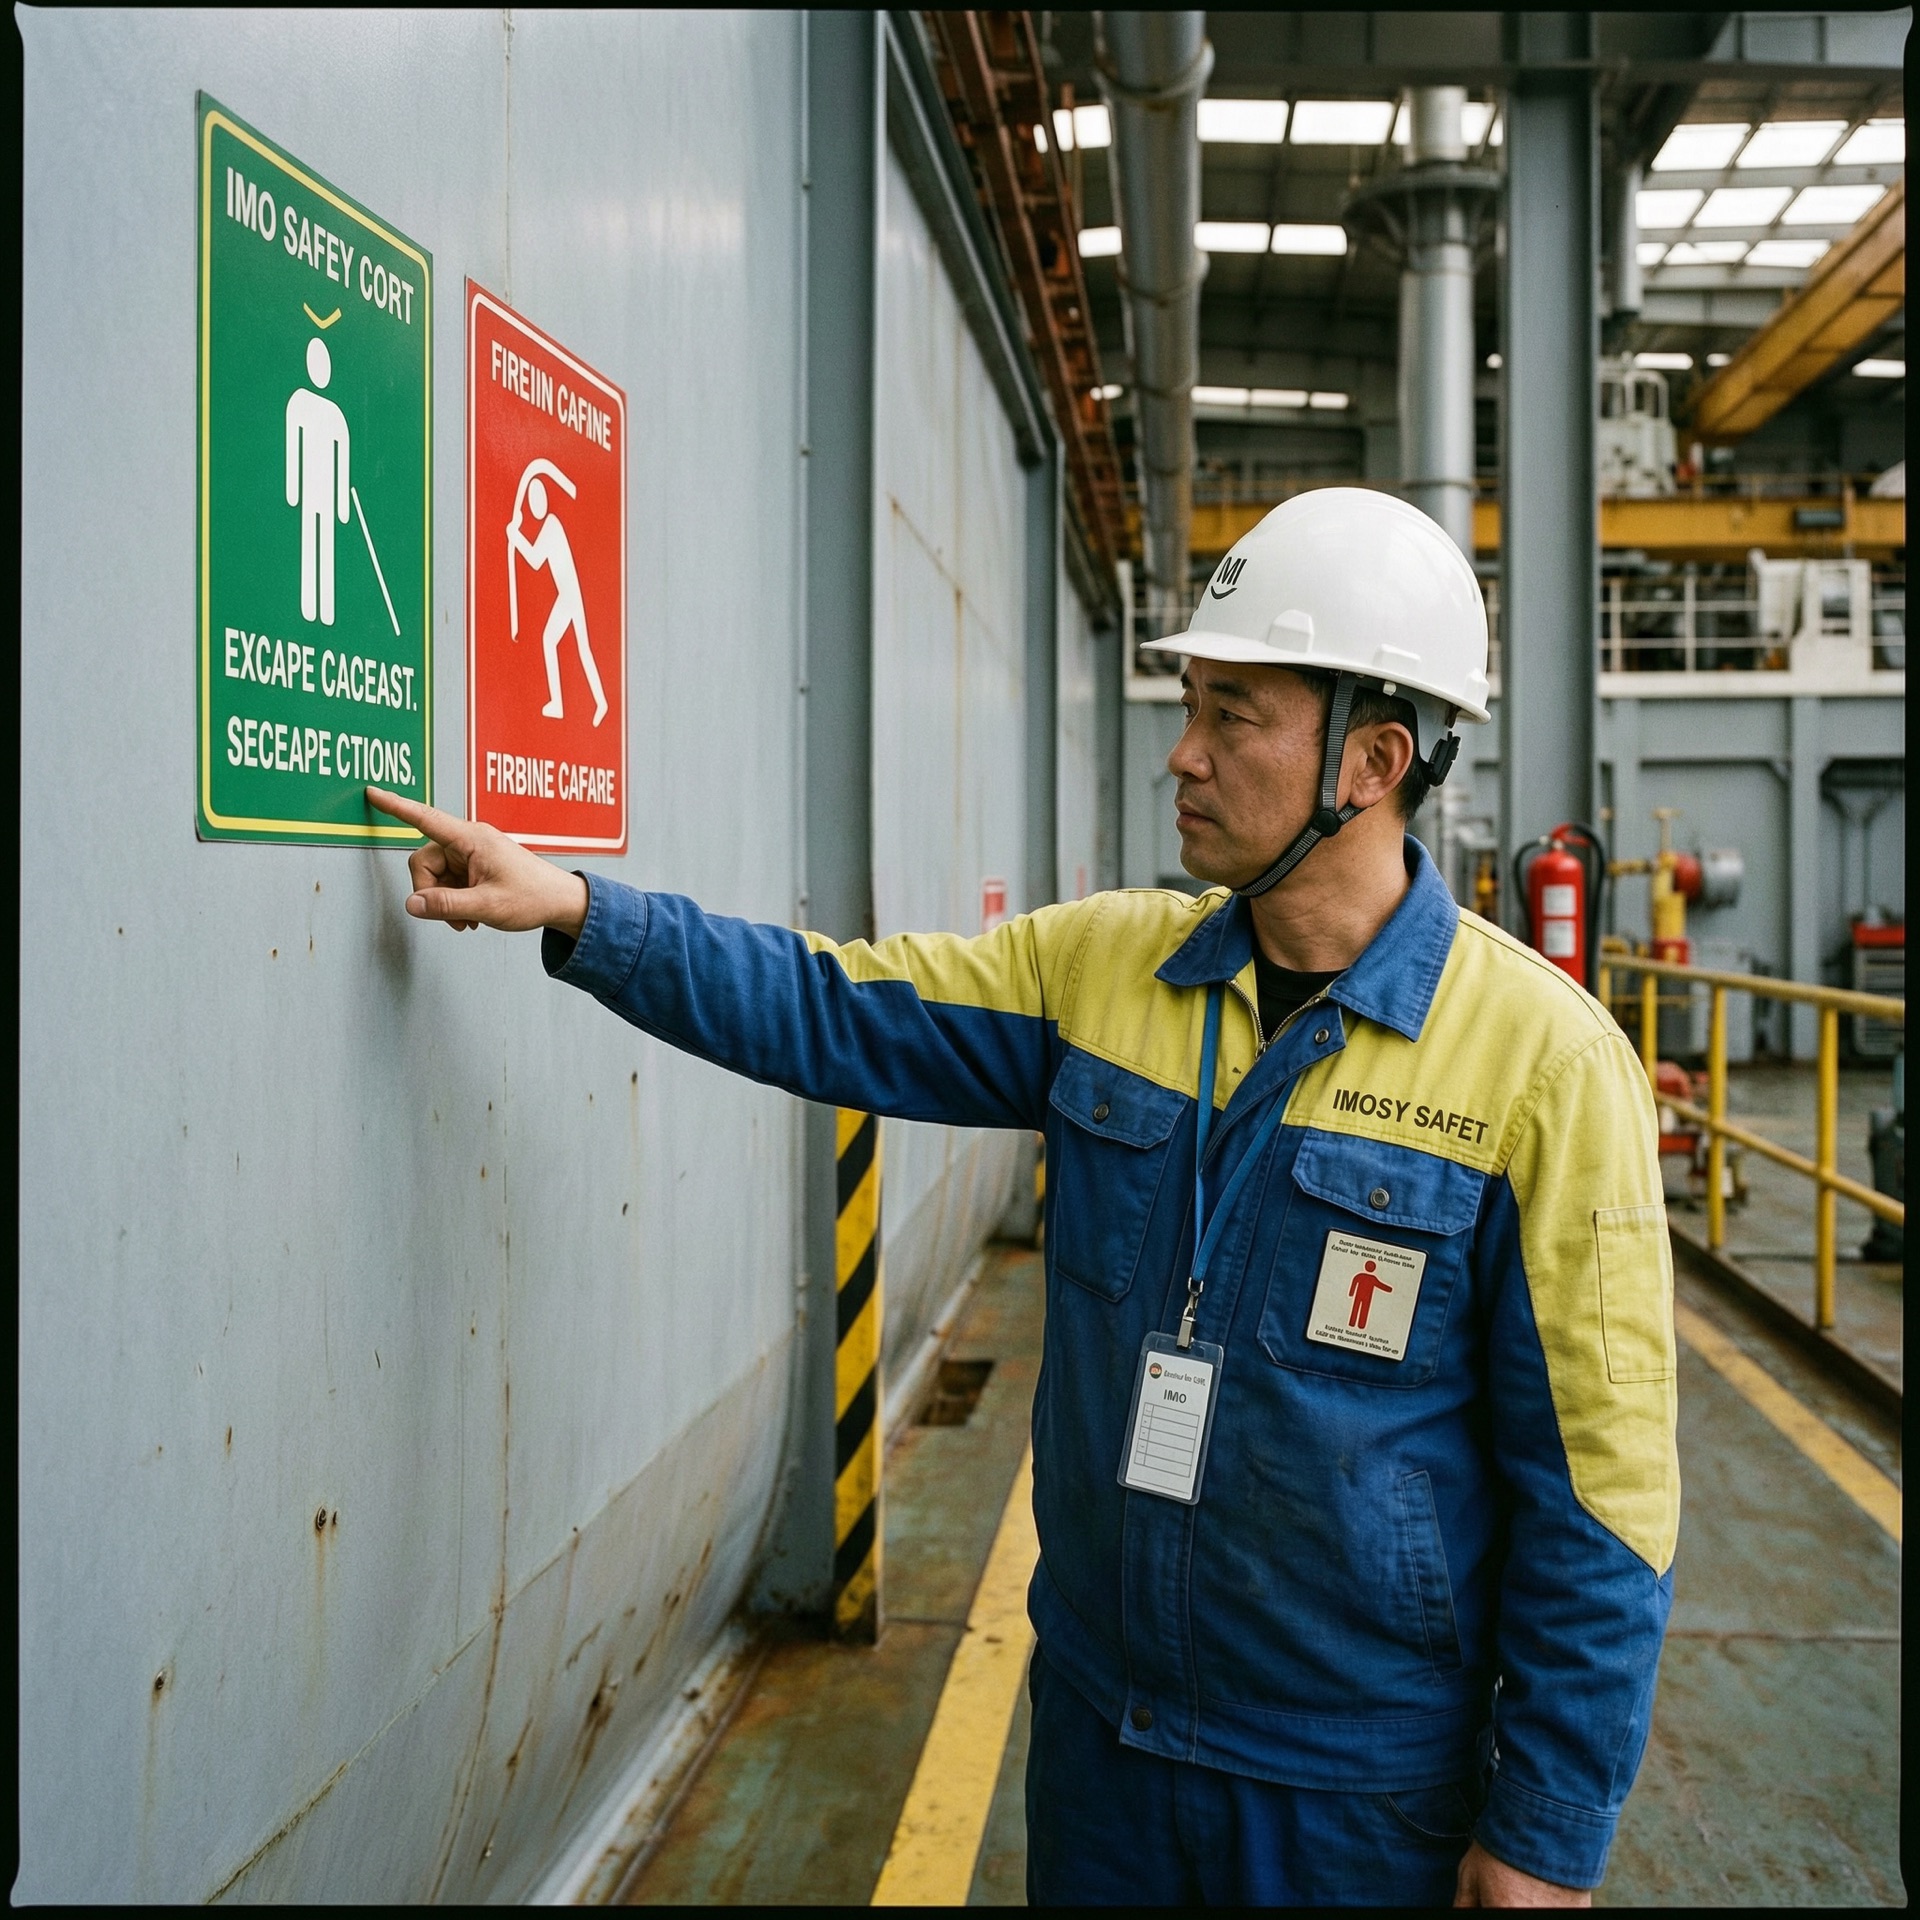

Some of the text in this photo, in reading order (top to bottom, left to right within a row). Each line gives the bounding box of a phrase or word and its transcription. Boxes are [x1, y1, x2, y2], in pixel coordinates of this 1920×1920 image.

[227, 166, 414, 325] IMO SAFEY CORT
[557, 384, 611, 452] CAFINE
[225, 627, 417, 711] EXCAPE CACEAST.
[227, 715, 416, 786] SECEAPE CTIONS.
[486, 751, 615, 806] FIRBINE CAFARE
[1332, 1089, 1489, 1144] IMOSY SAFET
[1163, 1389, 1187, 1404] IMO
